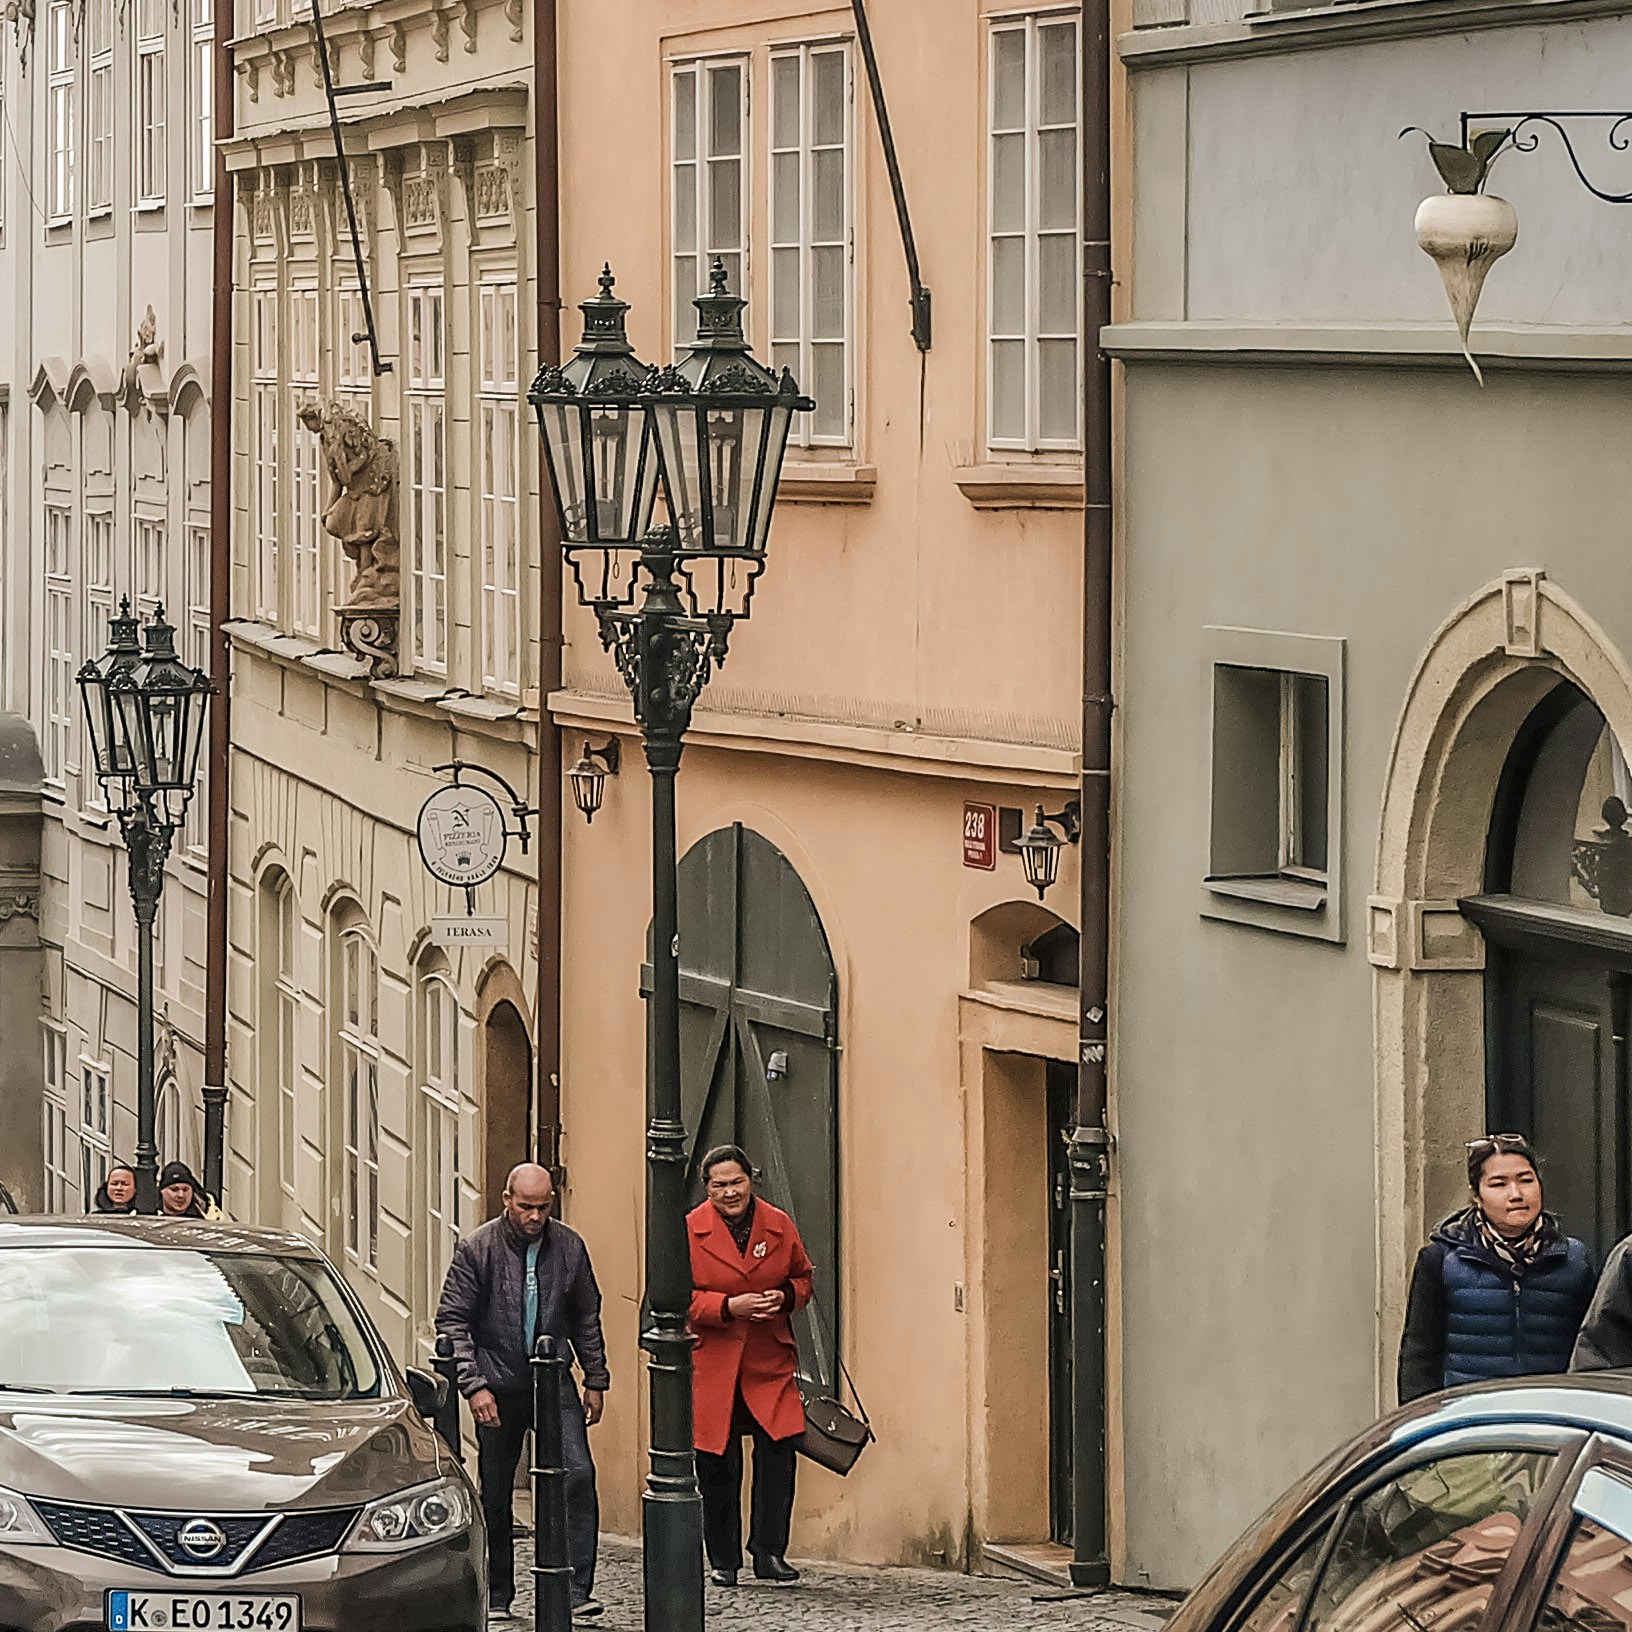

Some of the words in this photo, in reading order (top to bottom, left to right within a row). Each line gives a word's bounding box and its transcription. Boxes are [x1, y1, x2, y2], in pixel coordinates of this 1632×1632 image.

[965, 811, 985, 839] 238
[446, 927, 492, 937] TERASA
[183, 1535, 221, 1543] NISSAN
[130, 1598, 150, 1628] K
[217, 1599, 293, 1631] 1349
